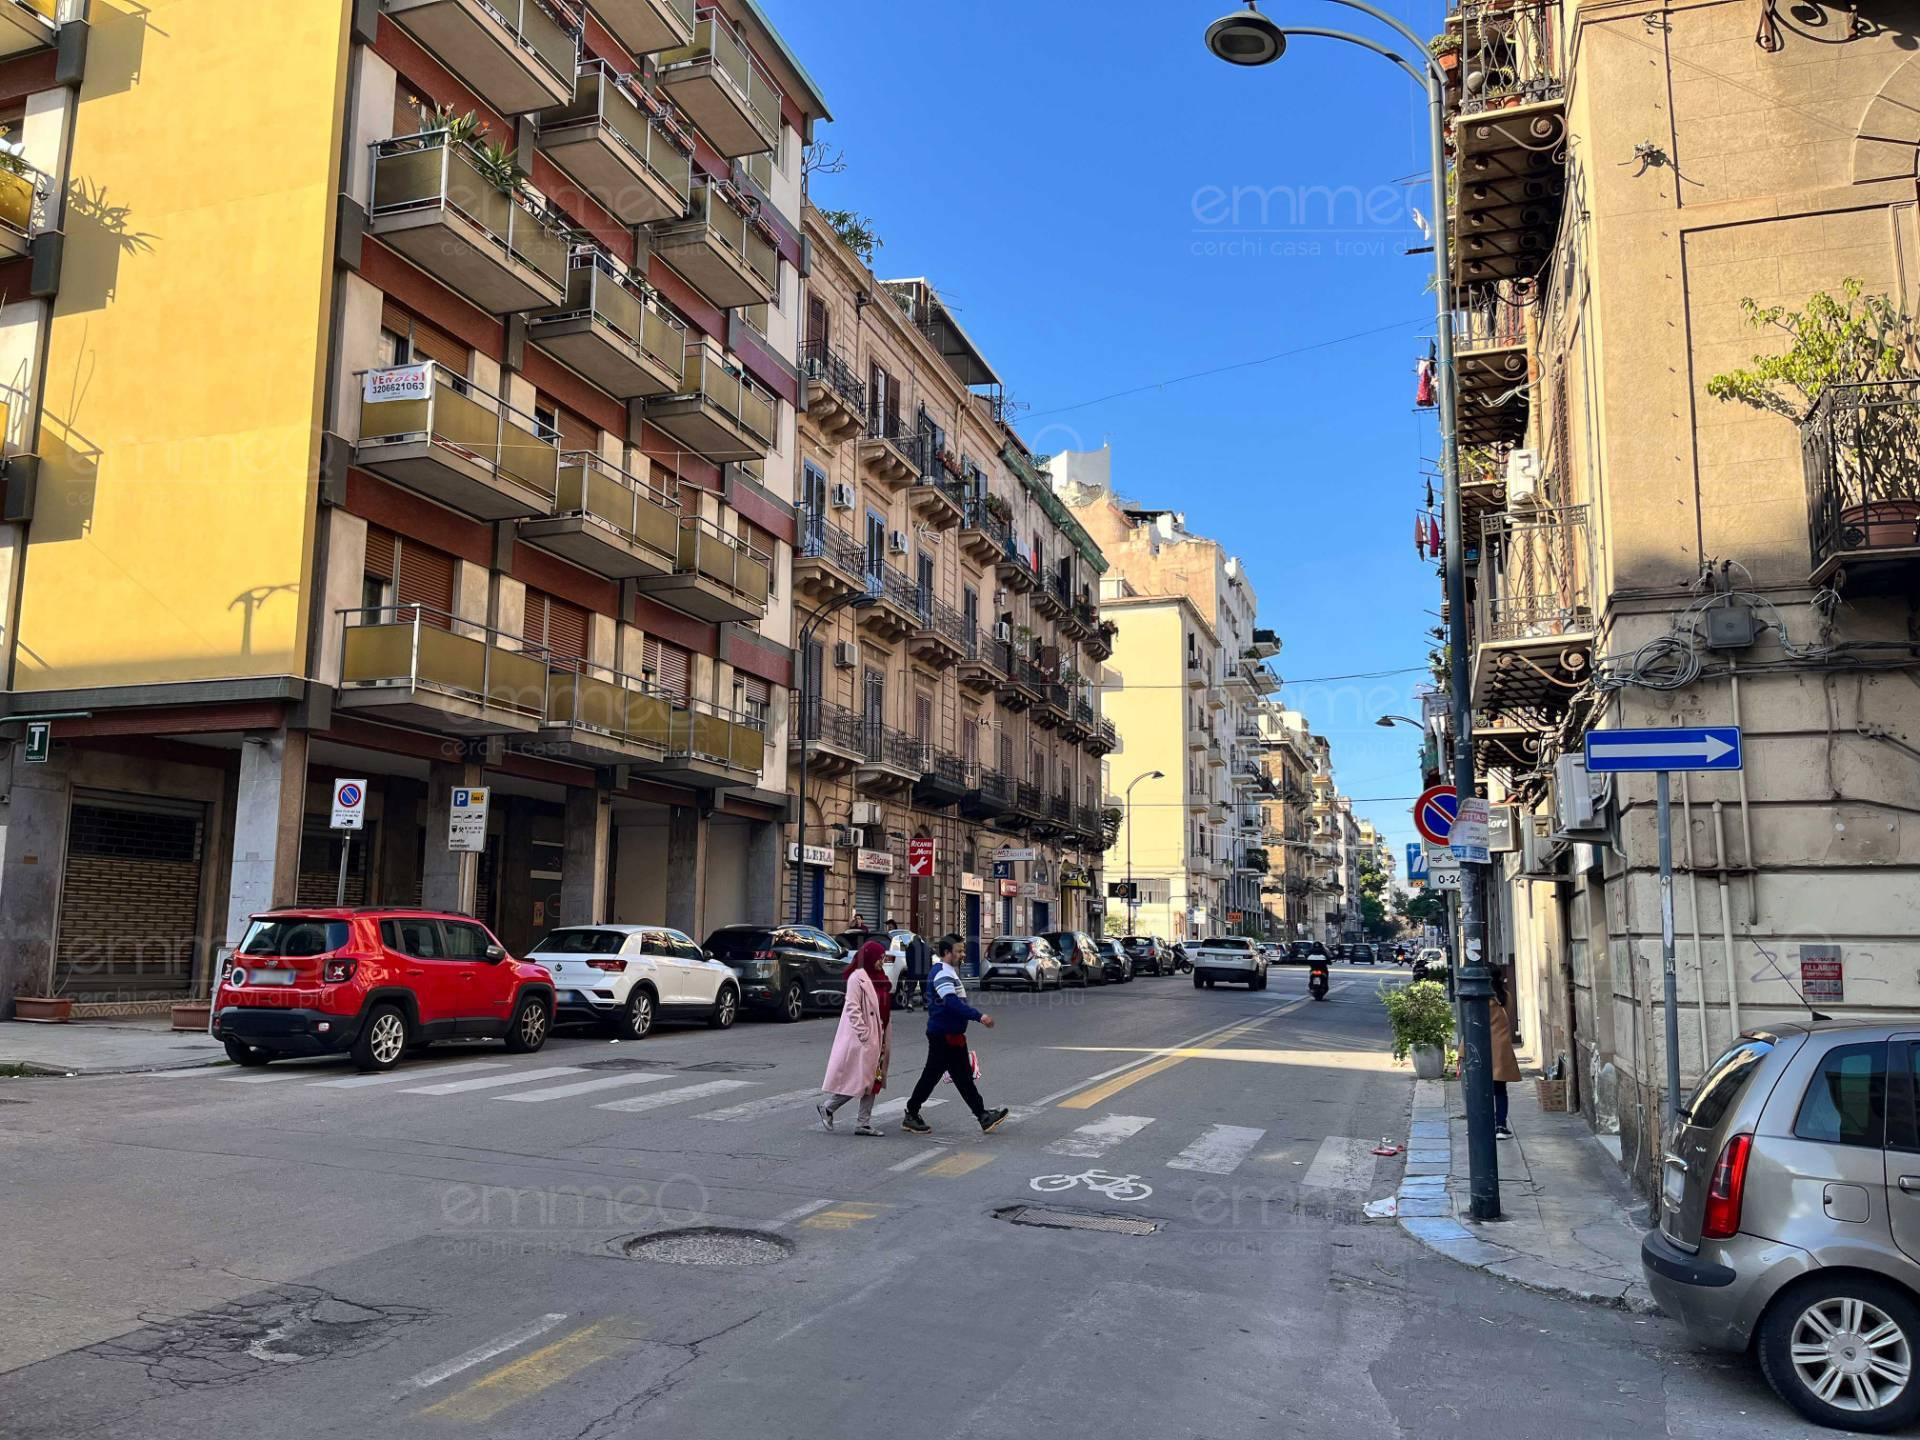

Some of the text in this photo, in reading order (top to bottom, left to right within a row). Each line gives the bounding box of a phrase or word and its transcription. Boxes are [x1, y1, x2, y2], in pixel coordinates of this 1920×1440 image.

[372, 371, 426, 386] VENDESI
[372, 382, 425, 394] 3206621063
[31, 727, 46, 751] T
[456, 792, 466, 805] P
[1803, 963, 1840, 971] ALLARME
